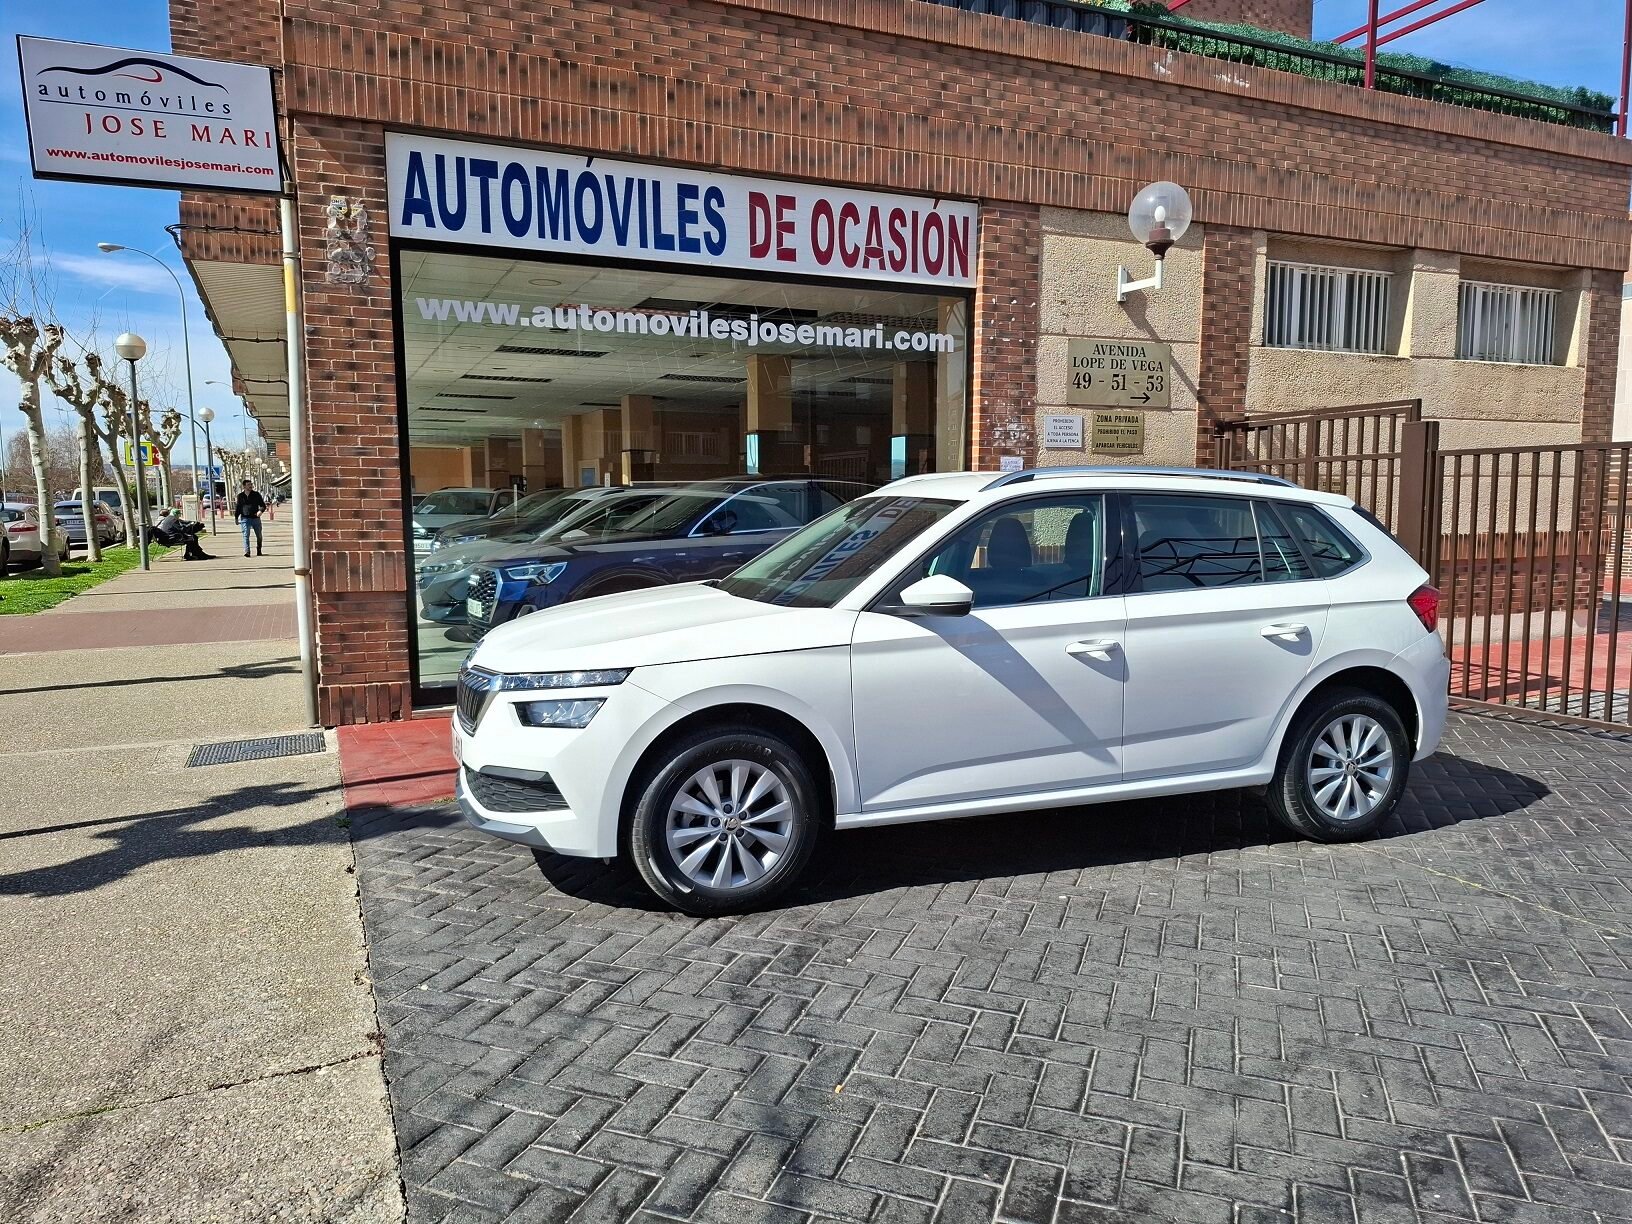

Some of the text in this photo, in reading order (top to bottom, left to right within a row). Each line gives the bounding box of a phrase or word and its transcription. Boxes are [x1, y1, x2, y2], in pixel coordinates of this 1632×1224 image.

[38, 84, 232, 115] automóviles
[84, 112, 272, 149] JOSE MARI
[46, 148, 274, 176] www.automovilesjosemari.com
[401, 150, 970, 278] AUTOMÓVILES DE OCASIÓN
[416, 297, 955, 353] www.automovilesjosemari.com
[1072, 356, 1164, 373] LOPE DE VEGA
[1092, 343, 1147, 358] AVENIDA
[1072, 371, 1092, 390] 49
[1111, 373, 1128, 391] 51
[1145, 374, 1164, 393] 53
[1096, 414, 1139, 424] ZONA PRIVADA
